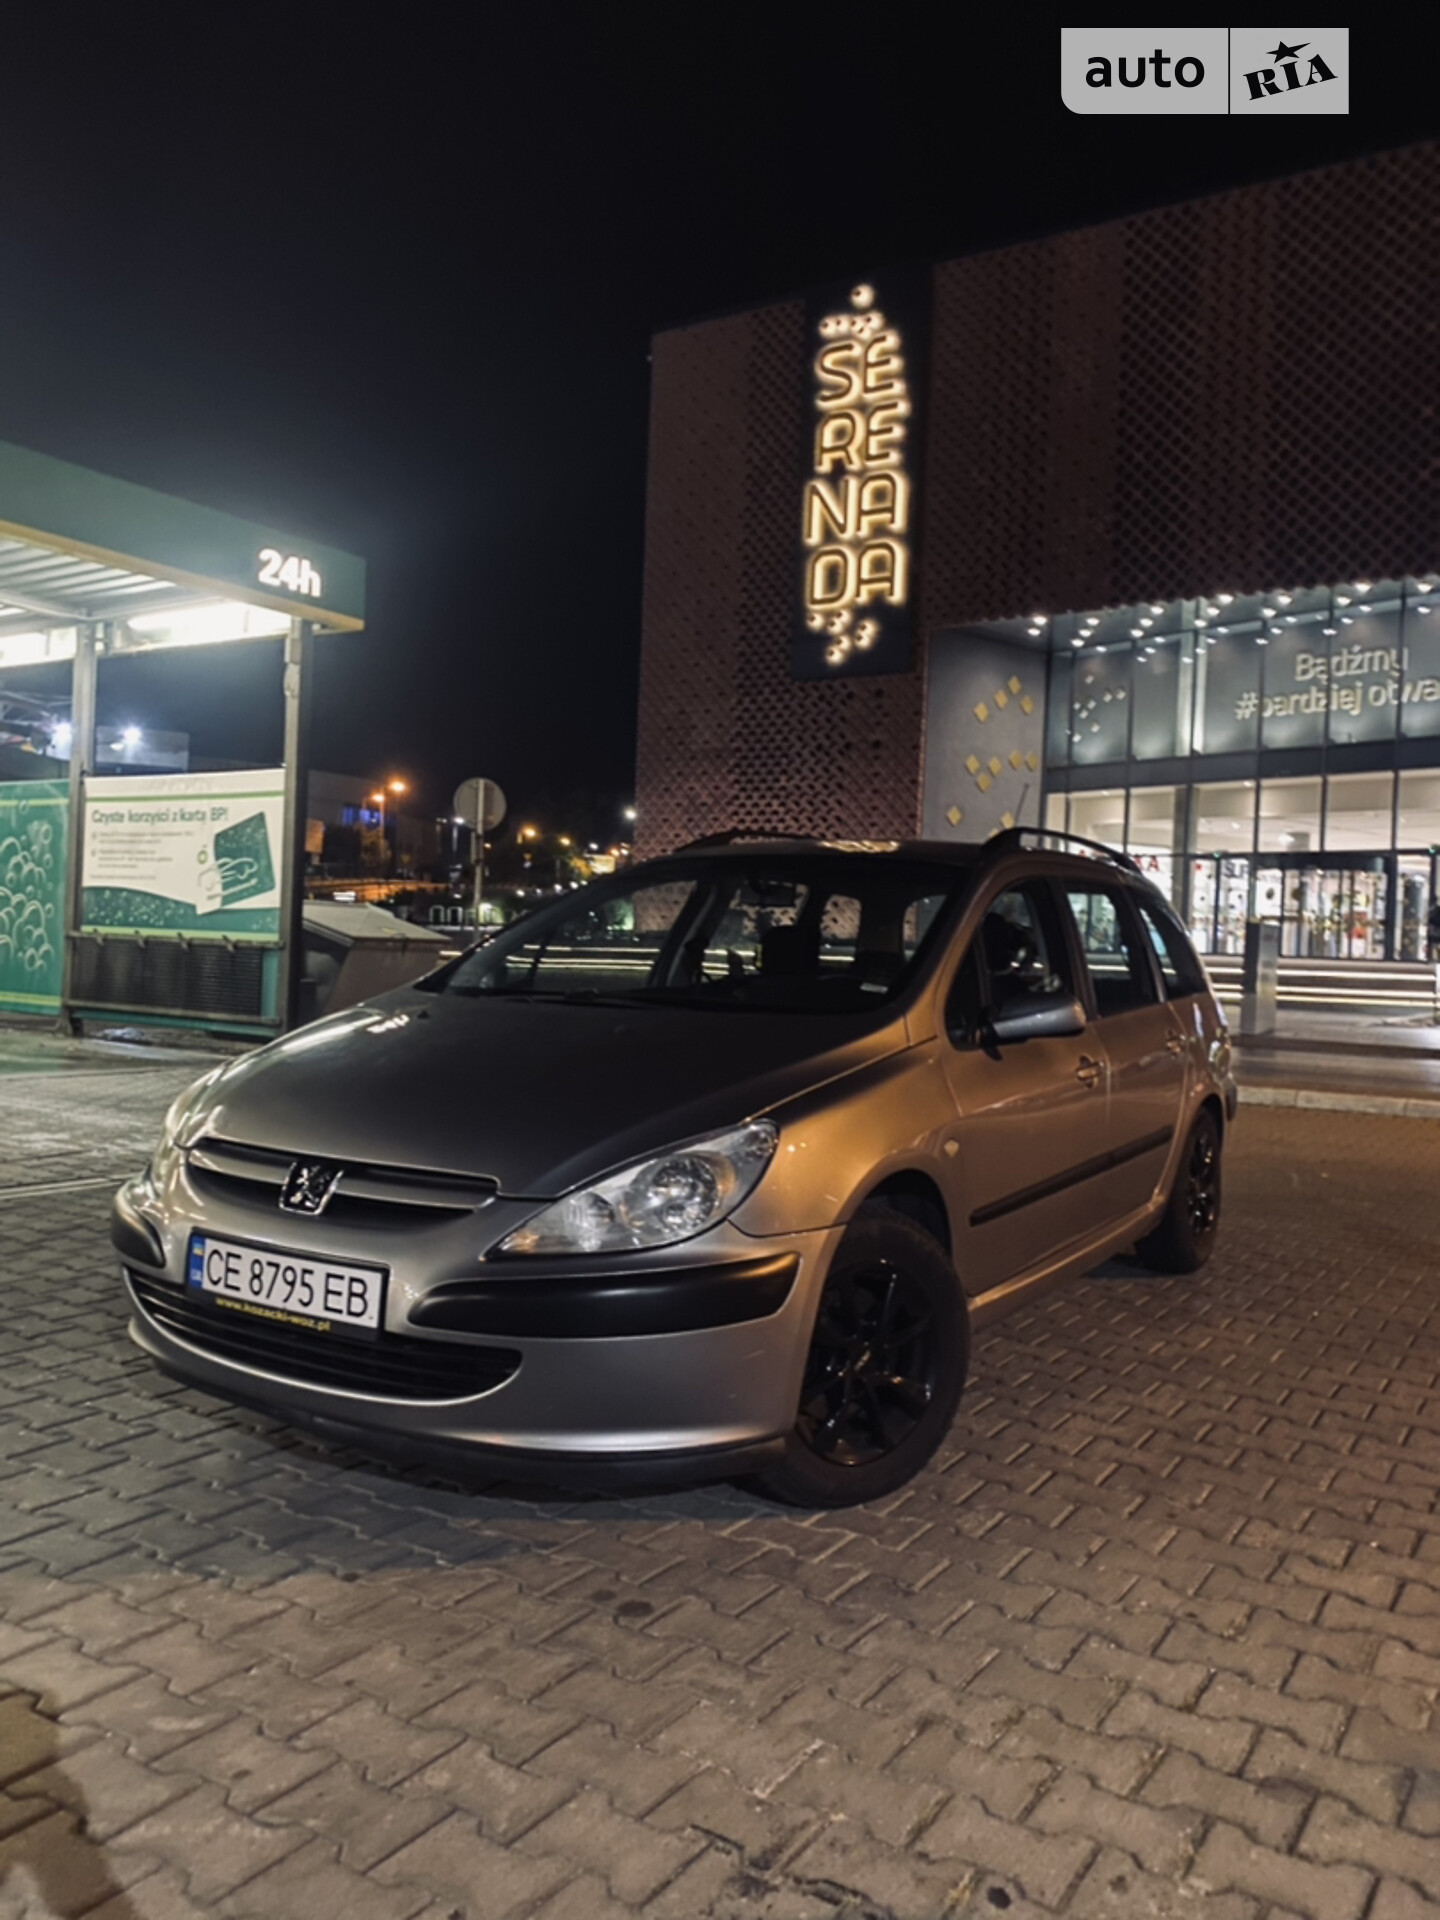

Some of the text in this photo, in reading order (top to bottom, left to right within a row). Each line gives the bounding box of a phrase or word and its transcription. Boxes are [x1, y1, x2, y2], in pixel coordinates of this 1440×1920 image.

[259, 548, 321, 597] 24h
[206, 1249, 368, 1318] CE 8795 EB
